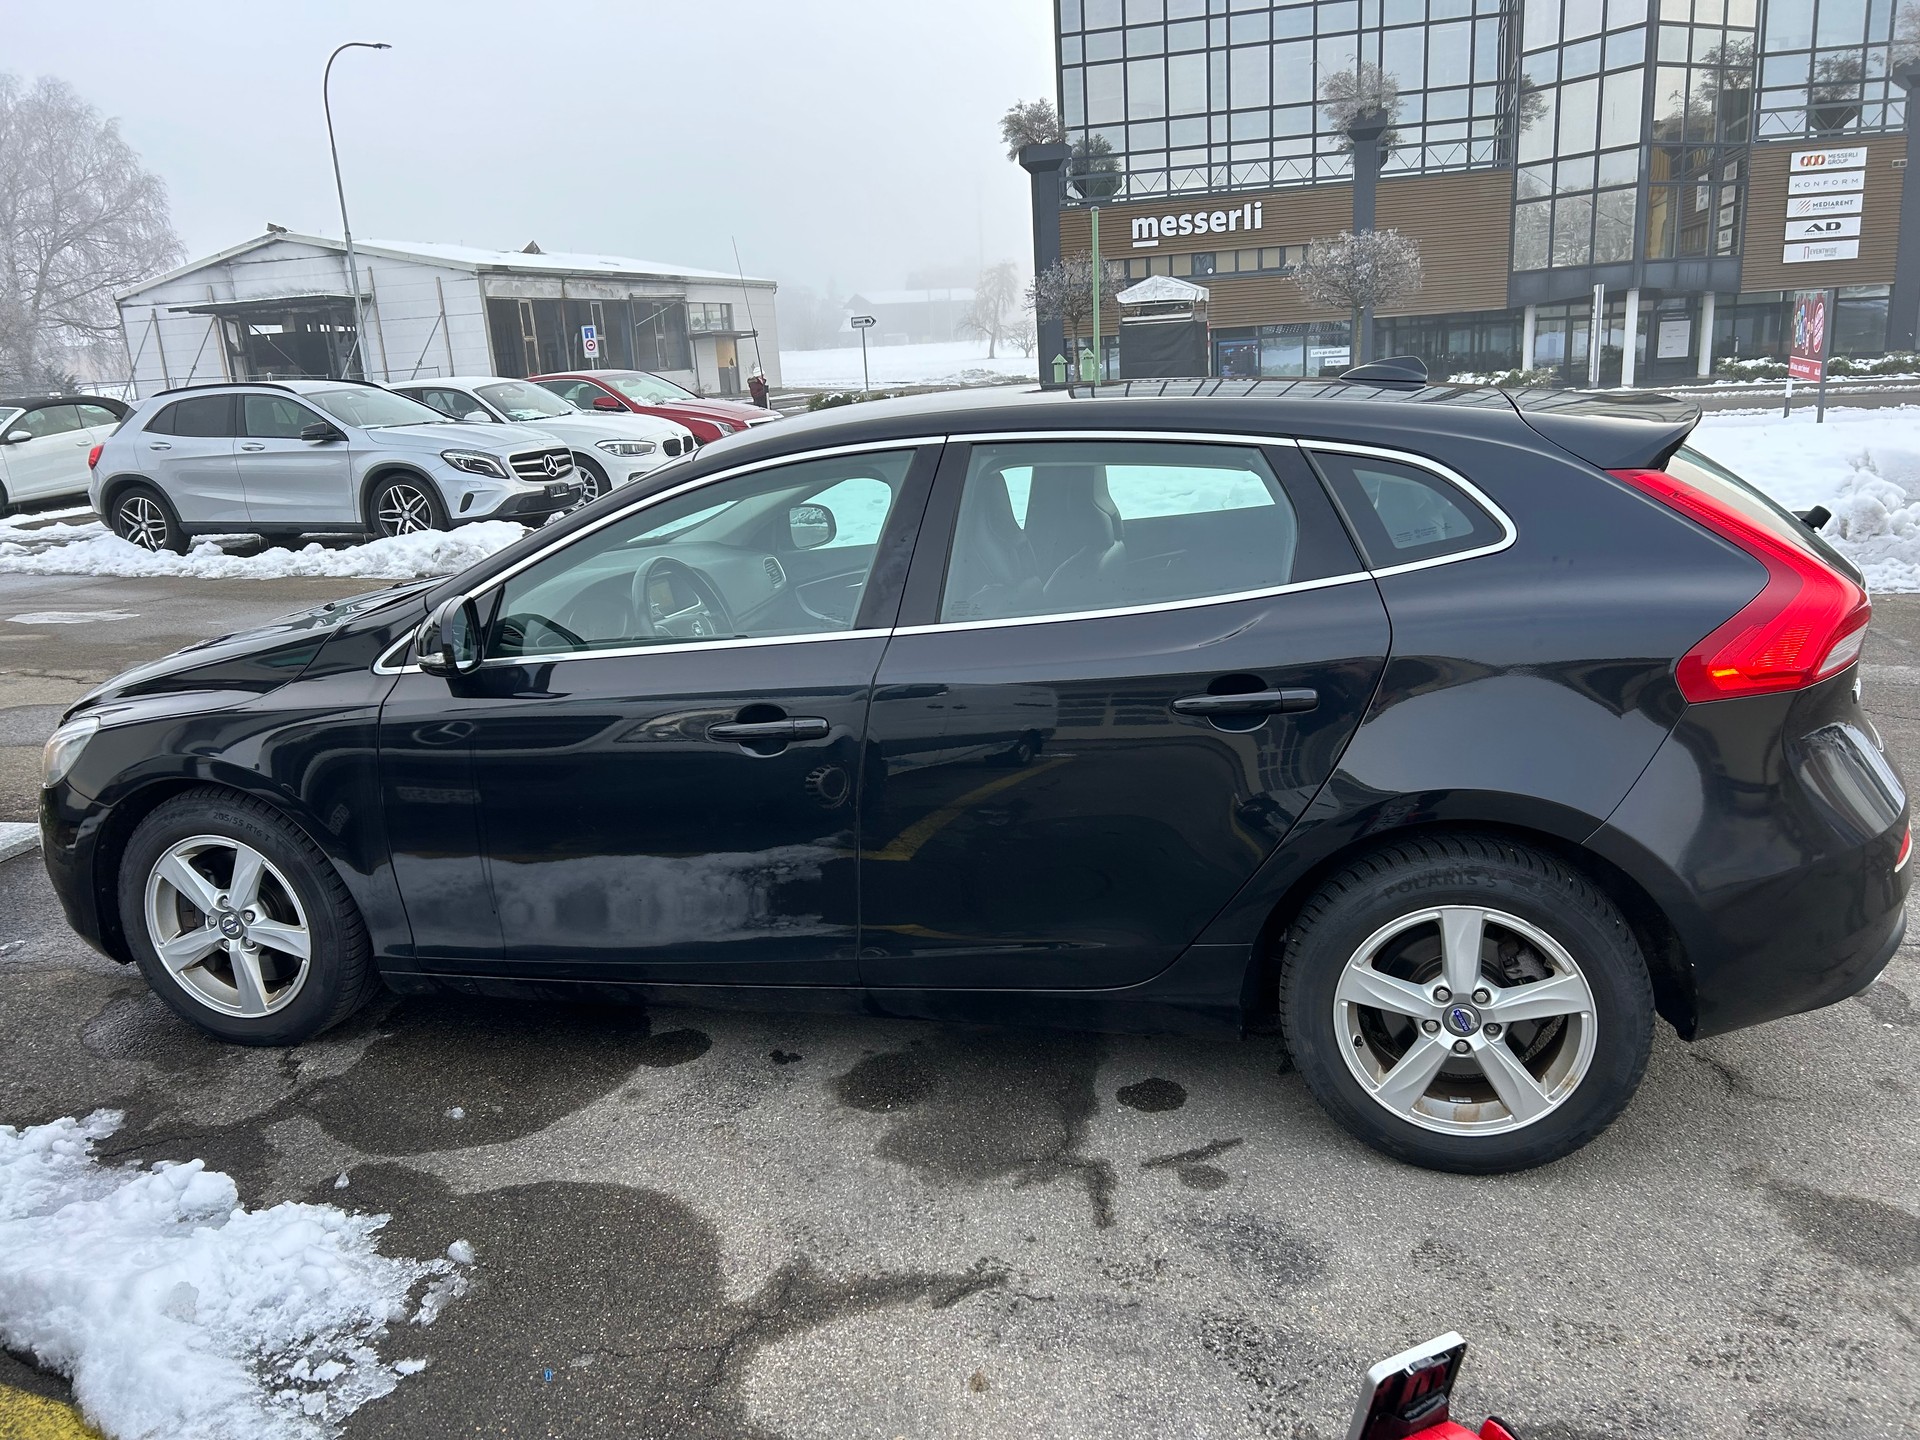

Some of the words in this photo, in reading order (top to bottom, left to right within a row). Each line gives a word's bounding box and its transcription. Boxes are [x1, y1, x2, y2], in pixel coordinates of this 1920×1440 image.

[1794, 179, 1859, 188] KONFORM
[1812, 200, 1854, 208] MEDIARENT
[1131, 201, 1262, 240] messerli
[1804, 221, 1842, 232] AD
[213, 811, 244, 826] 205/55
[245, 823, 263, 837] R16
[1384, 870, 1478, 899] POLARIS
